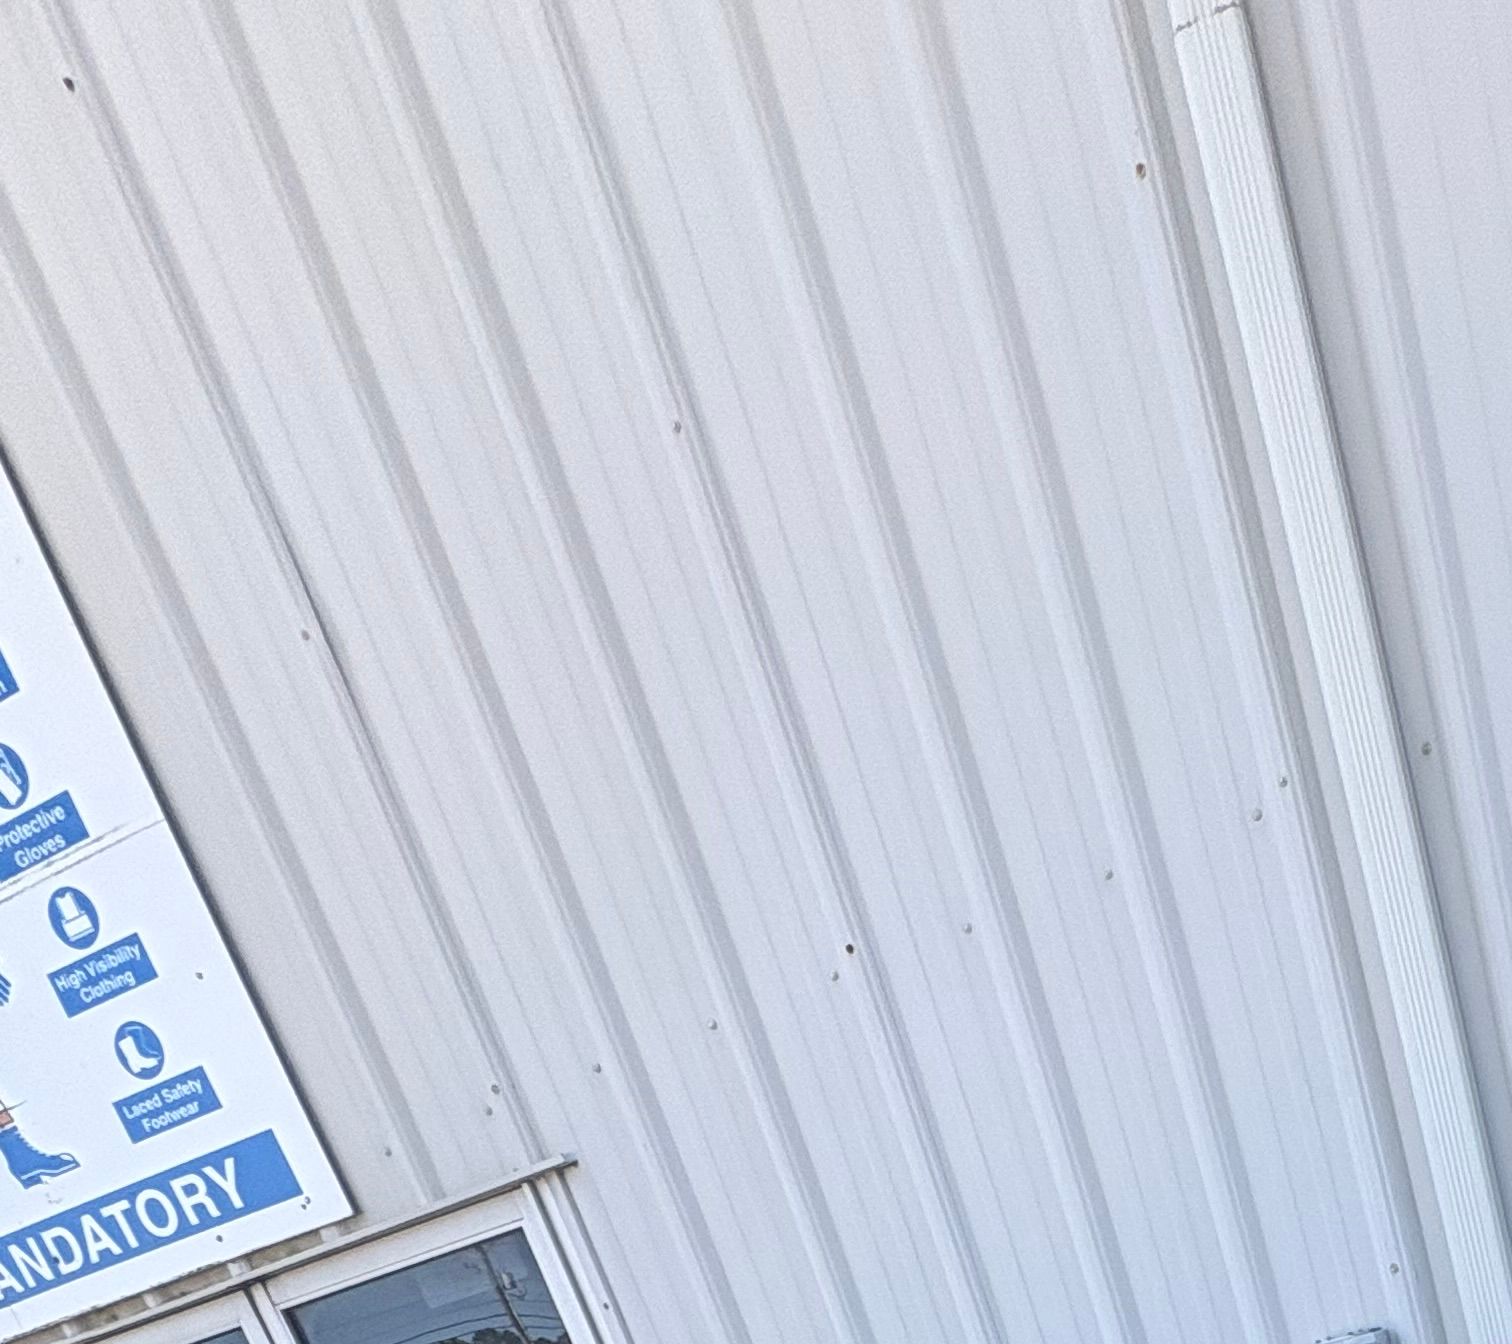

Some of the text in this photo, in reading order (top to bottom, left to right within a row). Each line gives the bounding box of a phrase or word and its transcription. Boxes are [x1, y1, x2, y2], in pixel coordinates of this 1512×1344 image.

[14, 834, 67, 868] Gloves
[54, 943, 142, 993] High Visibility
[79, 971, 137, 1004] Clothing
[121, 1078, 203, 1120] Laced Safety
[140, 1101, 200, 1133] Footwear
